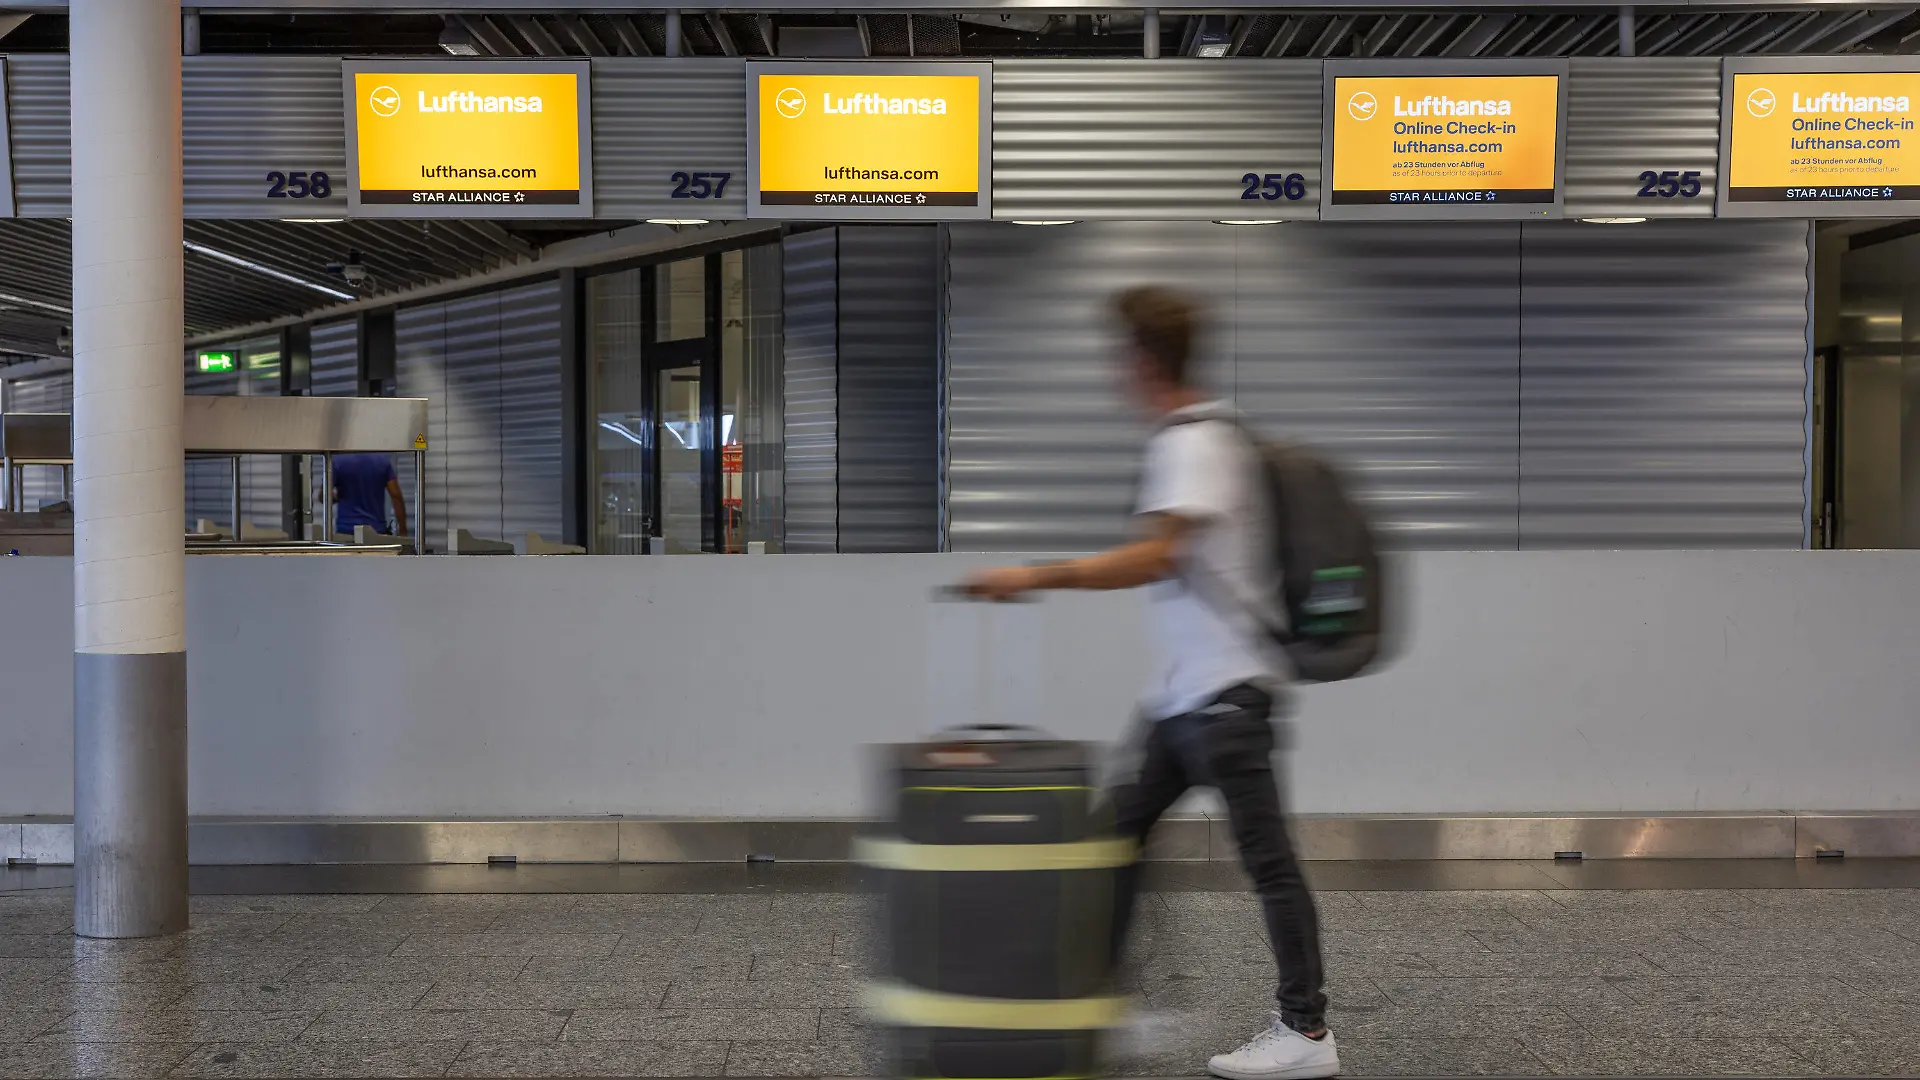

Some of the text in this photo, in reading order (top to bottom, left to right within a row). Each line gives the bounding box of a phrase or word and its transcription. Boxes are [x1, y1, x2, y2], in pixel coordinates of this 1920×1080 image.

[418, 91, 543, 113] Lufthansa
[823, 93, 947, 115] Lufthansa
[1394, 95, 1511, 116] Lufthansa
[1792, 92, 1909, 113] Lufthansa
[1393, 121, 1516, 135] Online Check-in
[1791, 117, 1914, 131] Online Check-in
[1393, 140, 1503, 154] lufthansa.com
[1791, 137, 1901, 150] lufthansa.com
[1460, 161, 1485, 169] Abflug
[1857, 157, 1883, 165] Abflug
[421, 165, 537, 179] lufthansa.com
[824, 166, 939, 180] lufthansa.com
[1467, 168, 1502, 177] departure
[1839, 166, 1855, 174] prior
[266, 171, 332, 198] 258
[671, 171, 731, 198] 257
[1241, 172, 1305, 200] 256
[1637, 170, 1702, 197] 255
[412, 192, 511, 202] STAR ALLIANCE
[814, 193, 912, 204] STAR ALLIANCE
[1389, 192, 1482, 201] STAR ALLIANCE
[1786, 188, 1879, 198] STAR ALLIANCE
